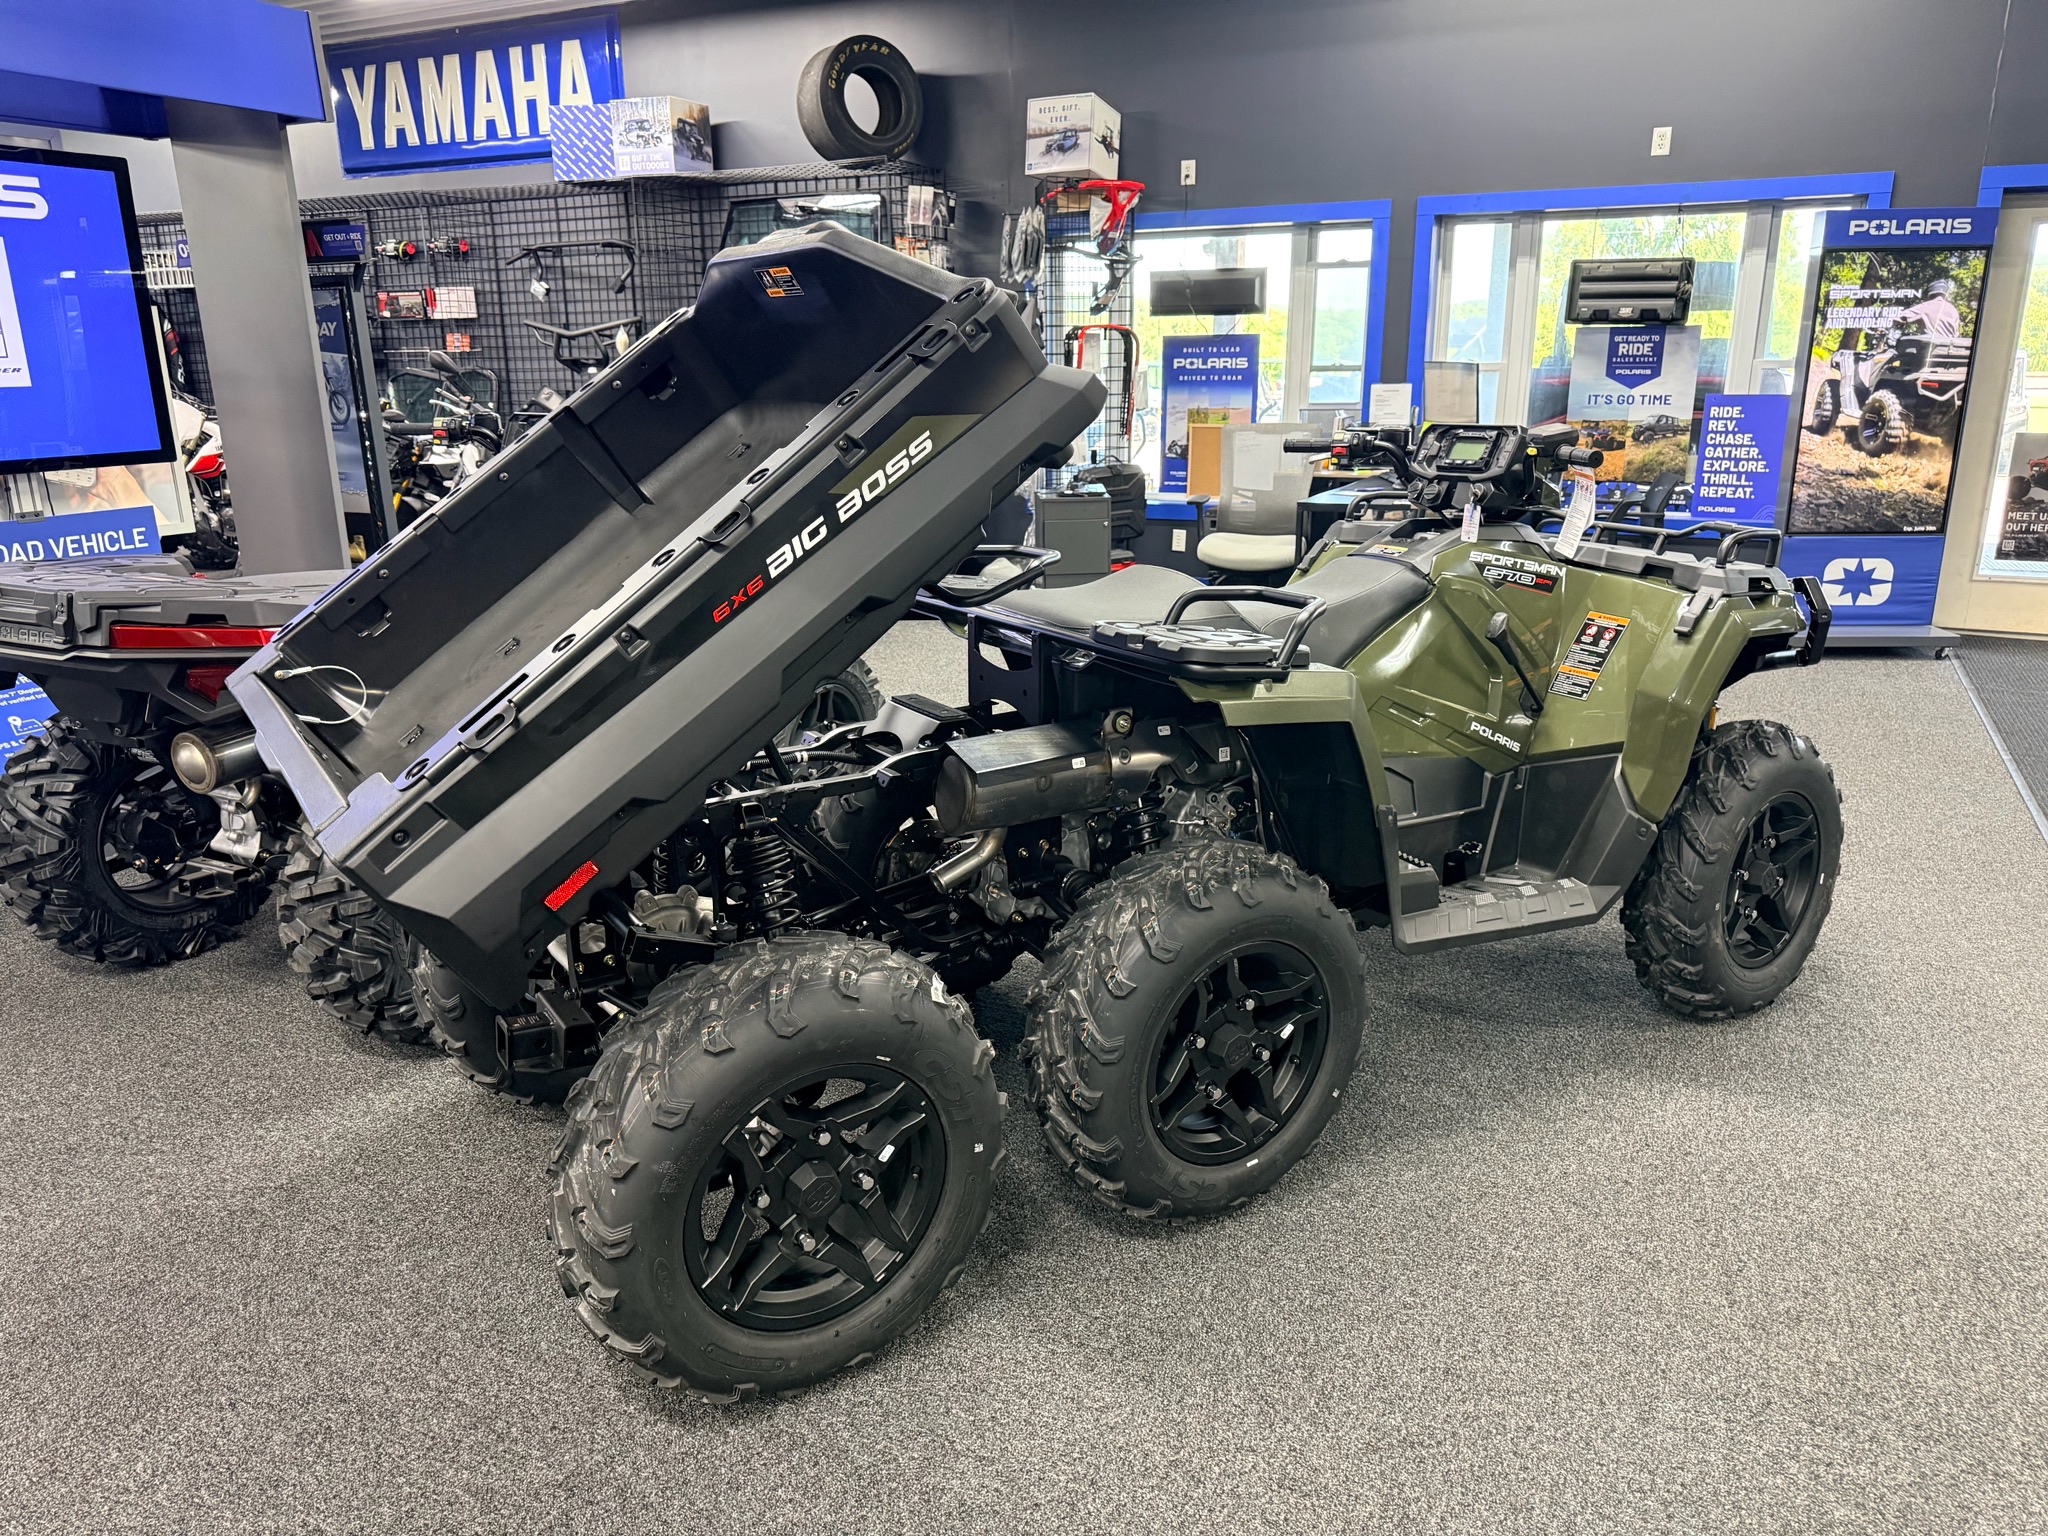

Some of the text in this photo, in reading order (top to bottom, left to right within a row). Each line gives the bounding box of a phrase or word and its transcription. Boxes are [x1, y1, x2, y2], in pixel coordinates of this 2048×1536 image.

[341, 39, 594, 150] YAMAHA
[1039, 104, 1080, 114] BEST. GIFT.
[631, 153, 664, 161] GIFT THE
[632, 160, 670, 170] OUTDOORS
[1848, 218, 1972, 236] POLARIS
[323, 234, 334, 242] GET
[334, 233, 346, 241] OUT
[350, 232, 362, 240] RIDE
[1829, 289, 1923, 300] SPORTSMAN
[1827, 306, 1905, 319] LEGENDARY RIDE
[1825, 317, 1894, 329] AND HANDLING
[1618, 343, 1654, 356] RIDE
[1173, 357, 1249, 370] POLARIS
[1587, 394, 1672, 406] IT'S GO TIME
[1709, 406, 1745, 418] RIDE.
[1708, 420, 1738, 432] REV.
[1706, 433, 1756, 446] CHASE.
[1705, 447, 1762, 459] GATHER.
[1703, 460, 1769, 473] EXPLORE.
[1702, 473, 1753, 485] THRILL.
[1700, 486, 1755, 499] REPEAT.
[765, 515, 828, 580] BIG
[835, 429, 933, 524] BOSS
[1697, 505, 1736, 513] POLARIS
[2007, 511, 2048, 521] MEET U
[2005, 523, 2028, 532] OUT
[48, 527, 149, 559] VEHICLE
[1469, 551, 1566, 577] SPORTSMAN
[1483, 566, 1536, 586] 570
[1470, 721, 1521, 753] POLARIS
